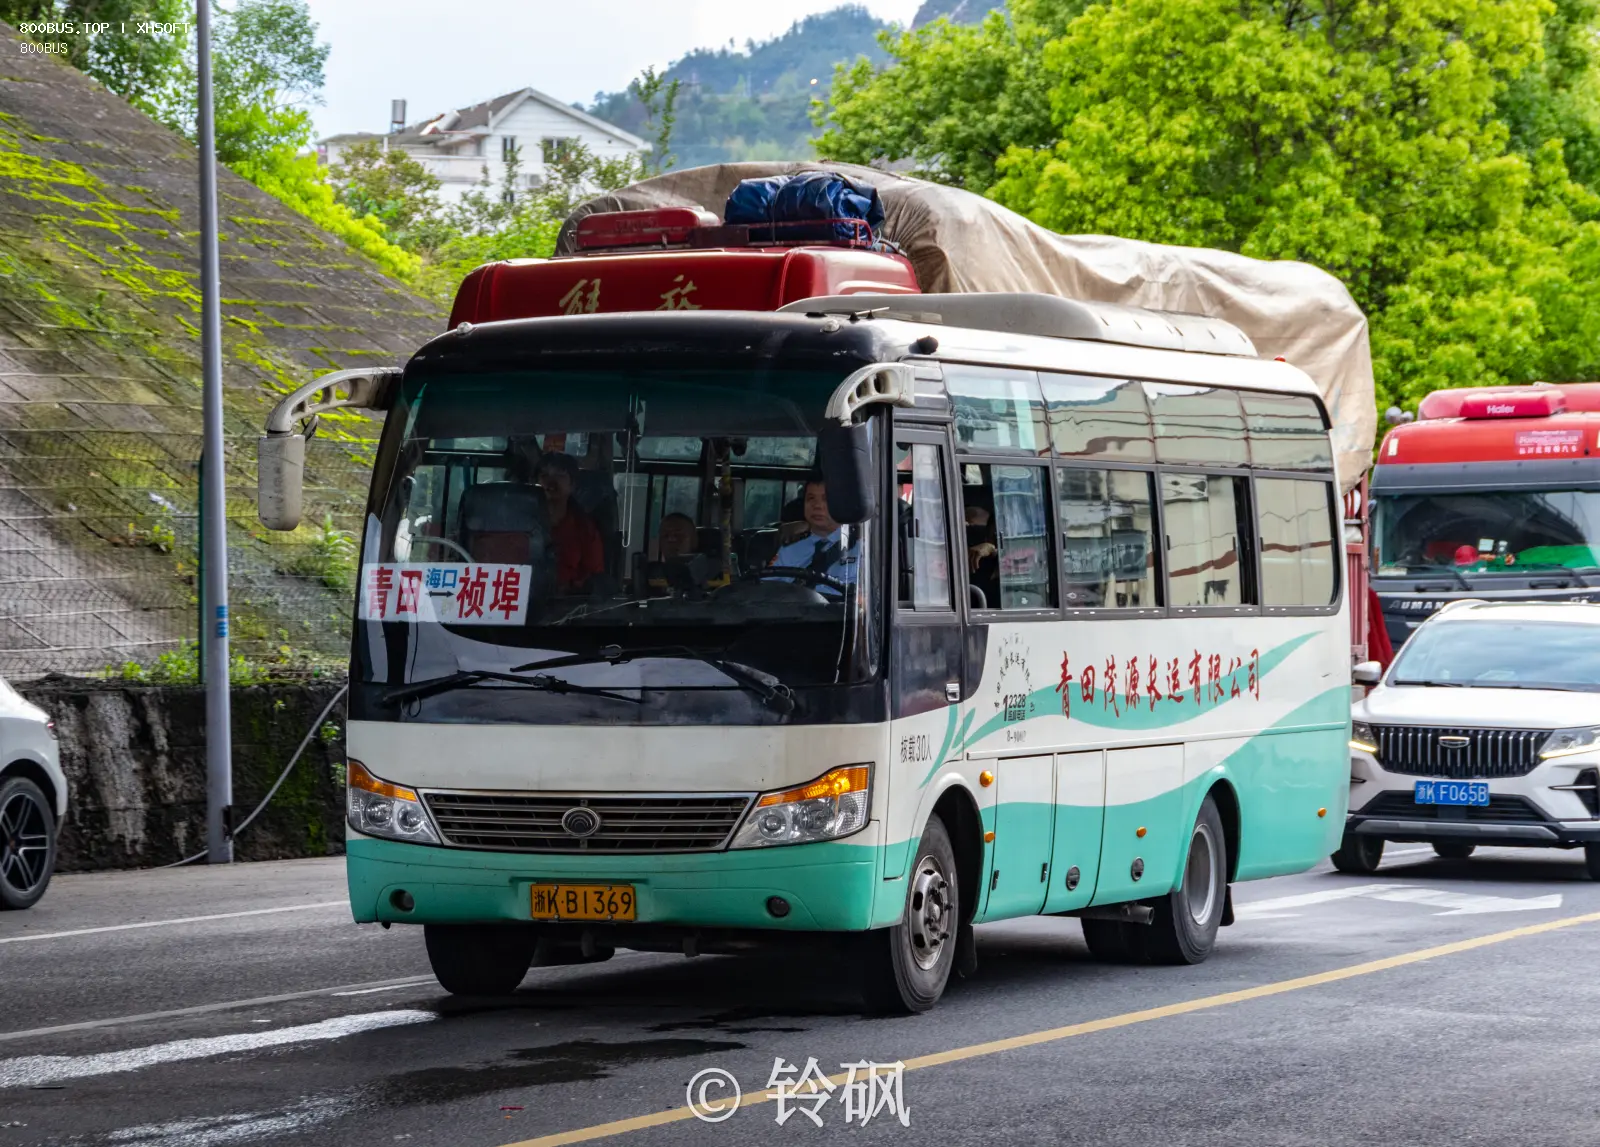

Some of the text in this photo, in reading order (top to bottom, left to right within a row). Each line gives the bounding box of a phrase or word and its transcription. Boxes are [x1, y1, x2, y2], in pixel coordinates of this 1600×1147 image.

[1486, 404, 1516, 414] Haier
[425, 567, 458, 589] 海口
[367, 566, 521, 620] 青田 祯埠
[1388, 600, 1445, 610] AUMAN
[1056, 648, 1260, 719] 青田茂源长运有限公司
